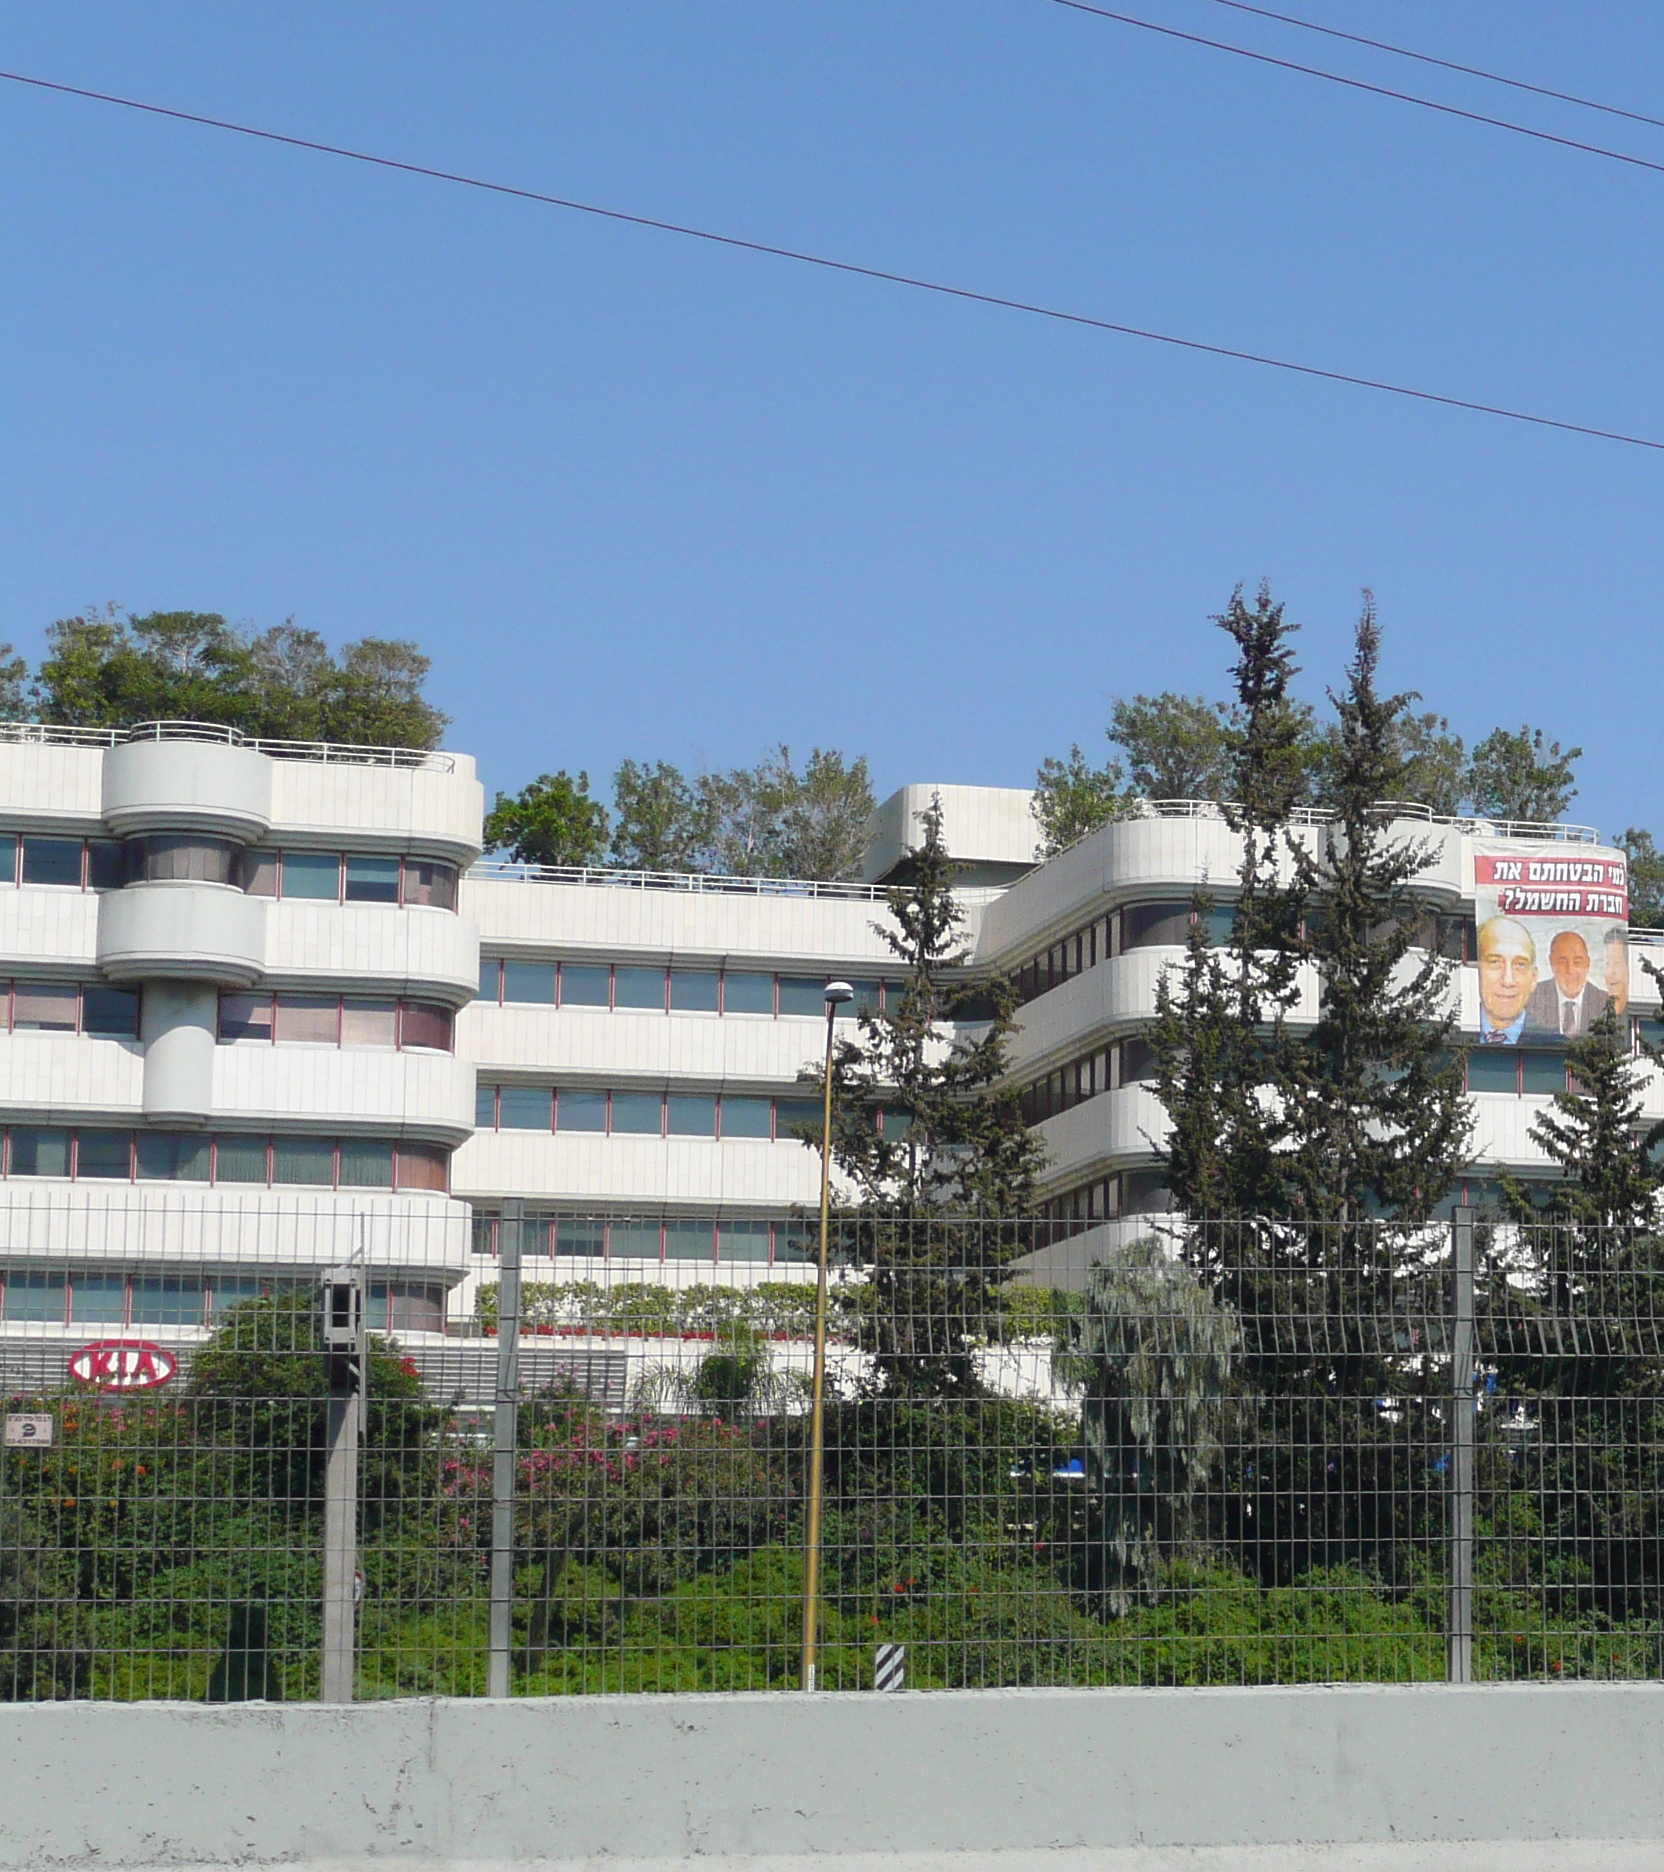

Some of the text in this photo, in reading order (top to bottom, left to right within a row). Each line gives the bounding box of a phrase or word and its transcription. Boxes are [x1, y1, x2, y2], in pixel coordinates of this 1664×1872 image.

[1493, 860, 1624, 886] למי הבטחתם את
[1503, 886, 1623, 915] חברת החשמל?
[89, 1351, 158, 1380] KIA
